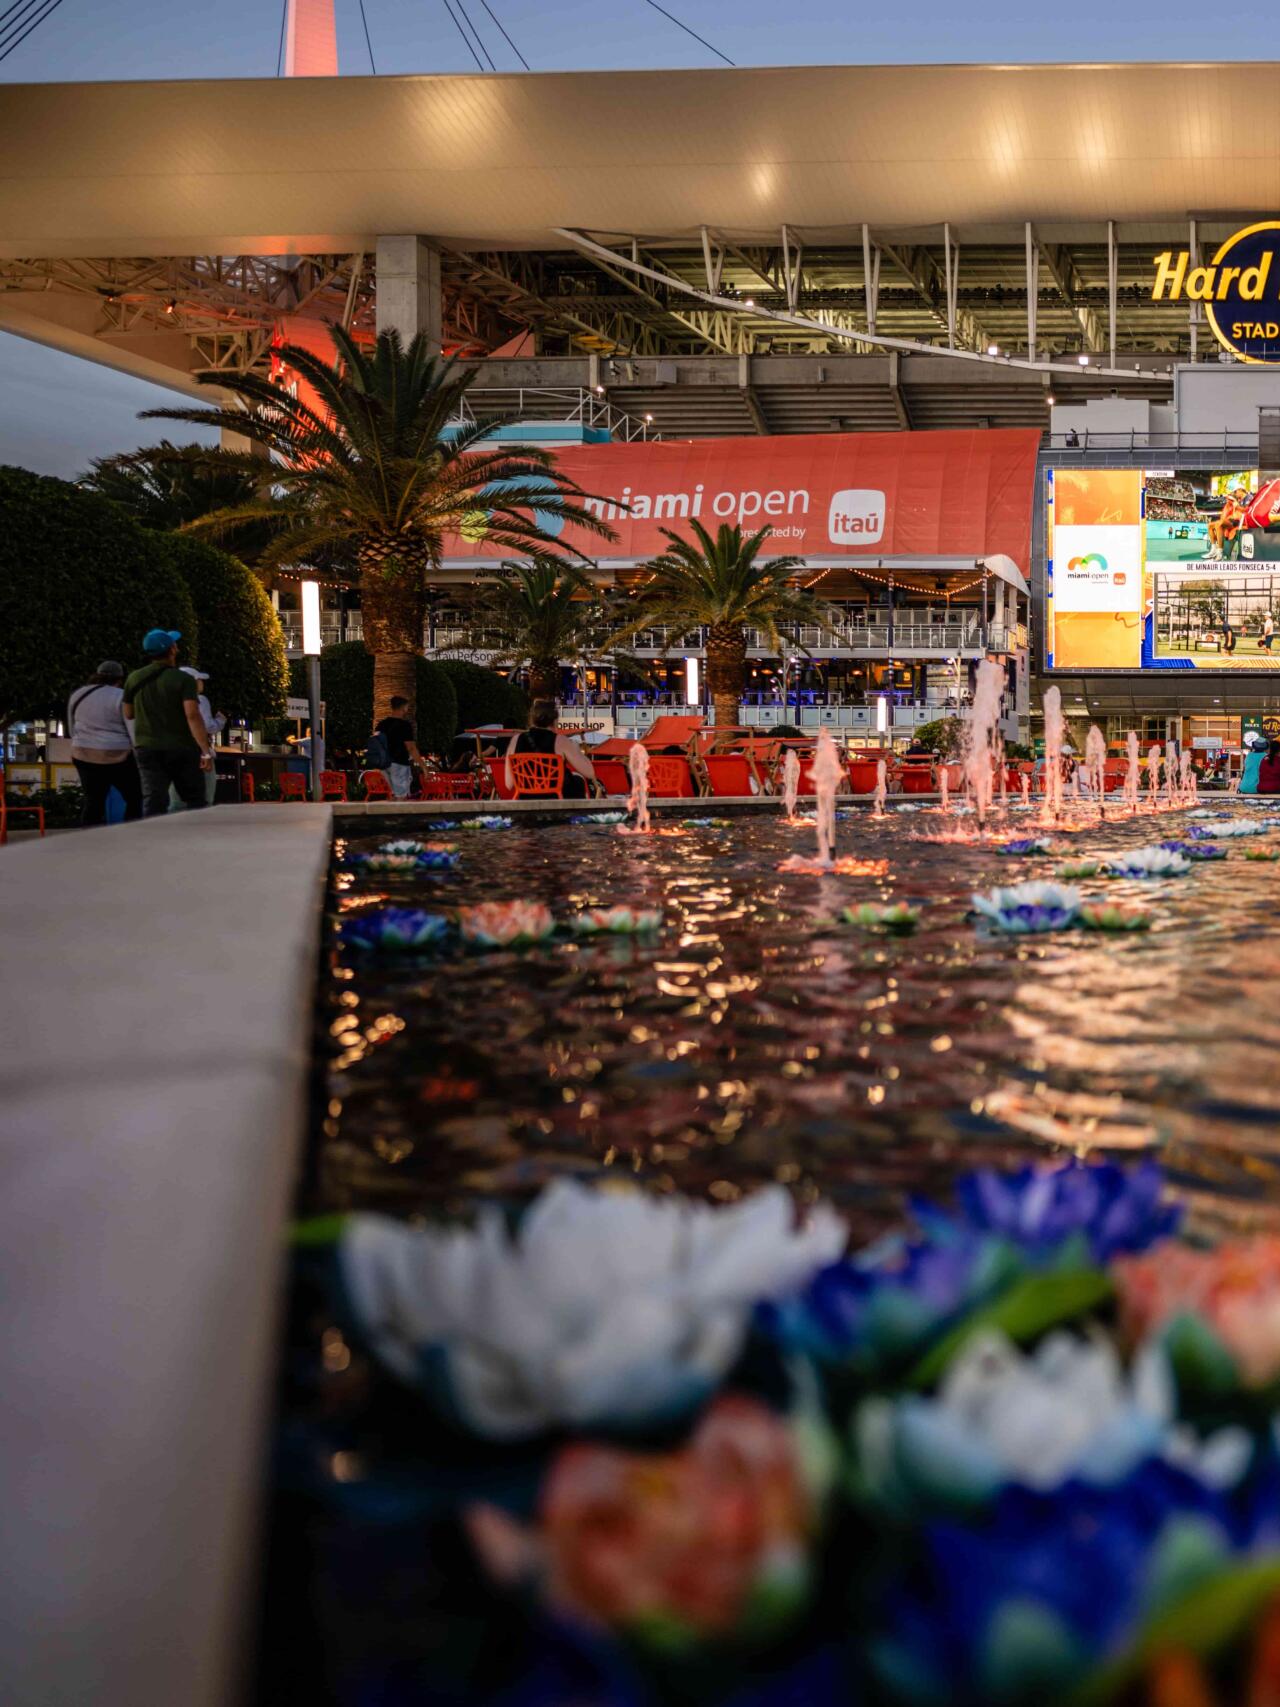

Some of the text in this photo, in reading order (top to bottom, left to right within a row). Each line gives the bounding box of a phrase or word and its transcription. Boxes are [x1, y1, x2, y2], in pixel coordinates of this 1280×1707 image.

[1151, 251, 1274, 300] Hard
[583, 484, 810, 525] miami open
[792, 526, 806, 539] by
[1195, 563, 1218, 571] MINAUR
[1219, 563, 1237, 571] LEADS
[1238, 563, 1264, 571] FONSECA
[1265, 563, 1277, 571] 5-4
[557, 722, 582, 731] OPEN
